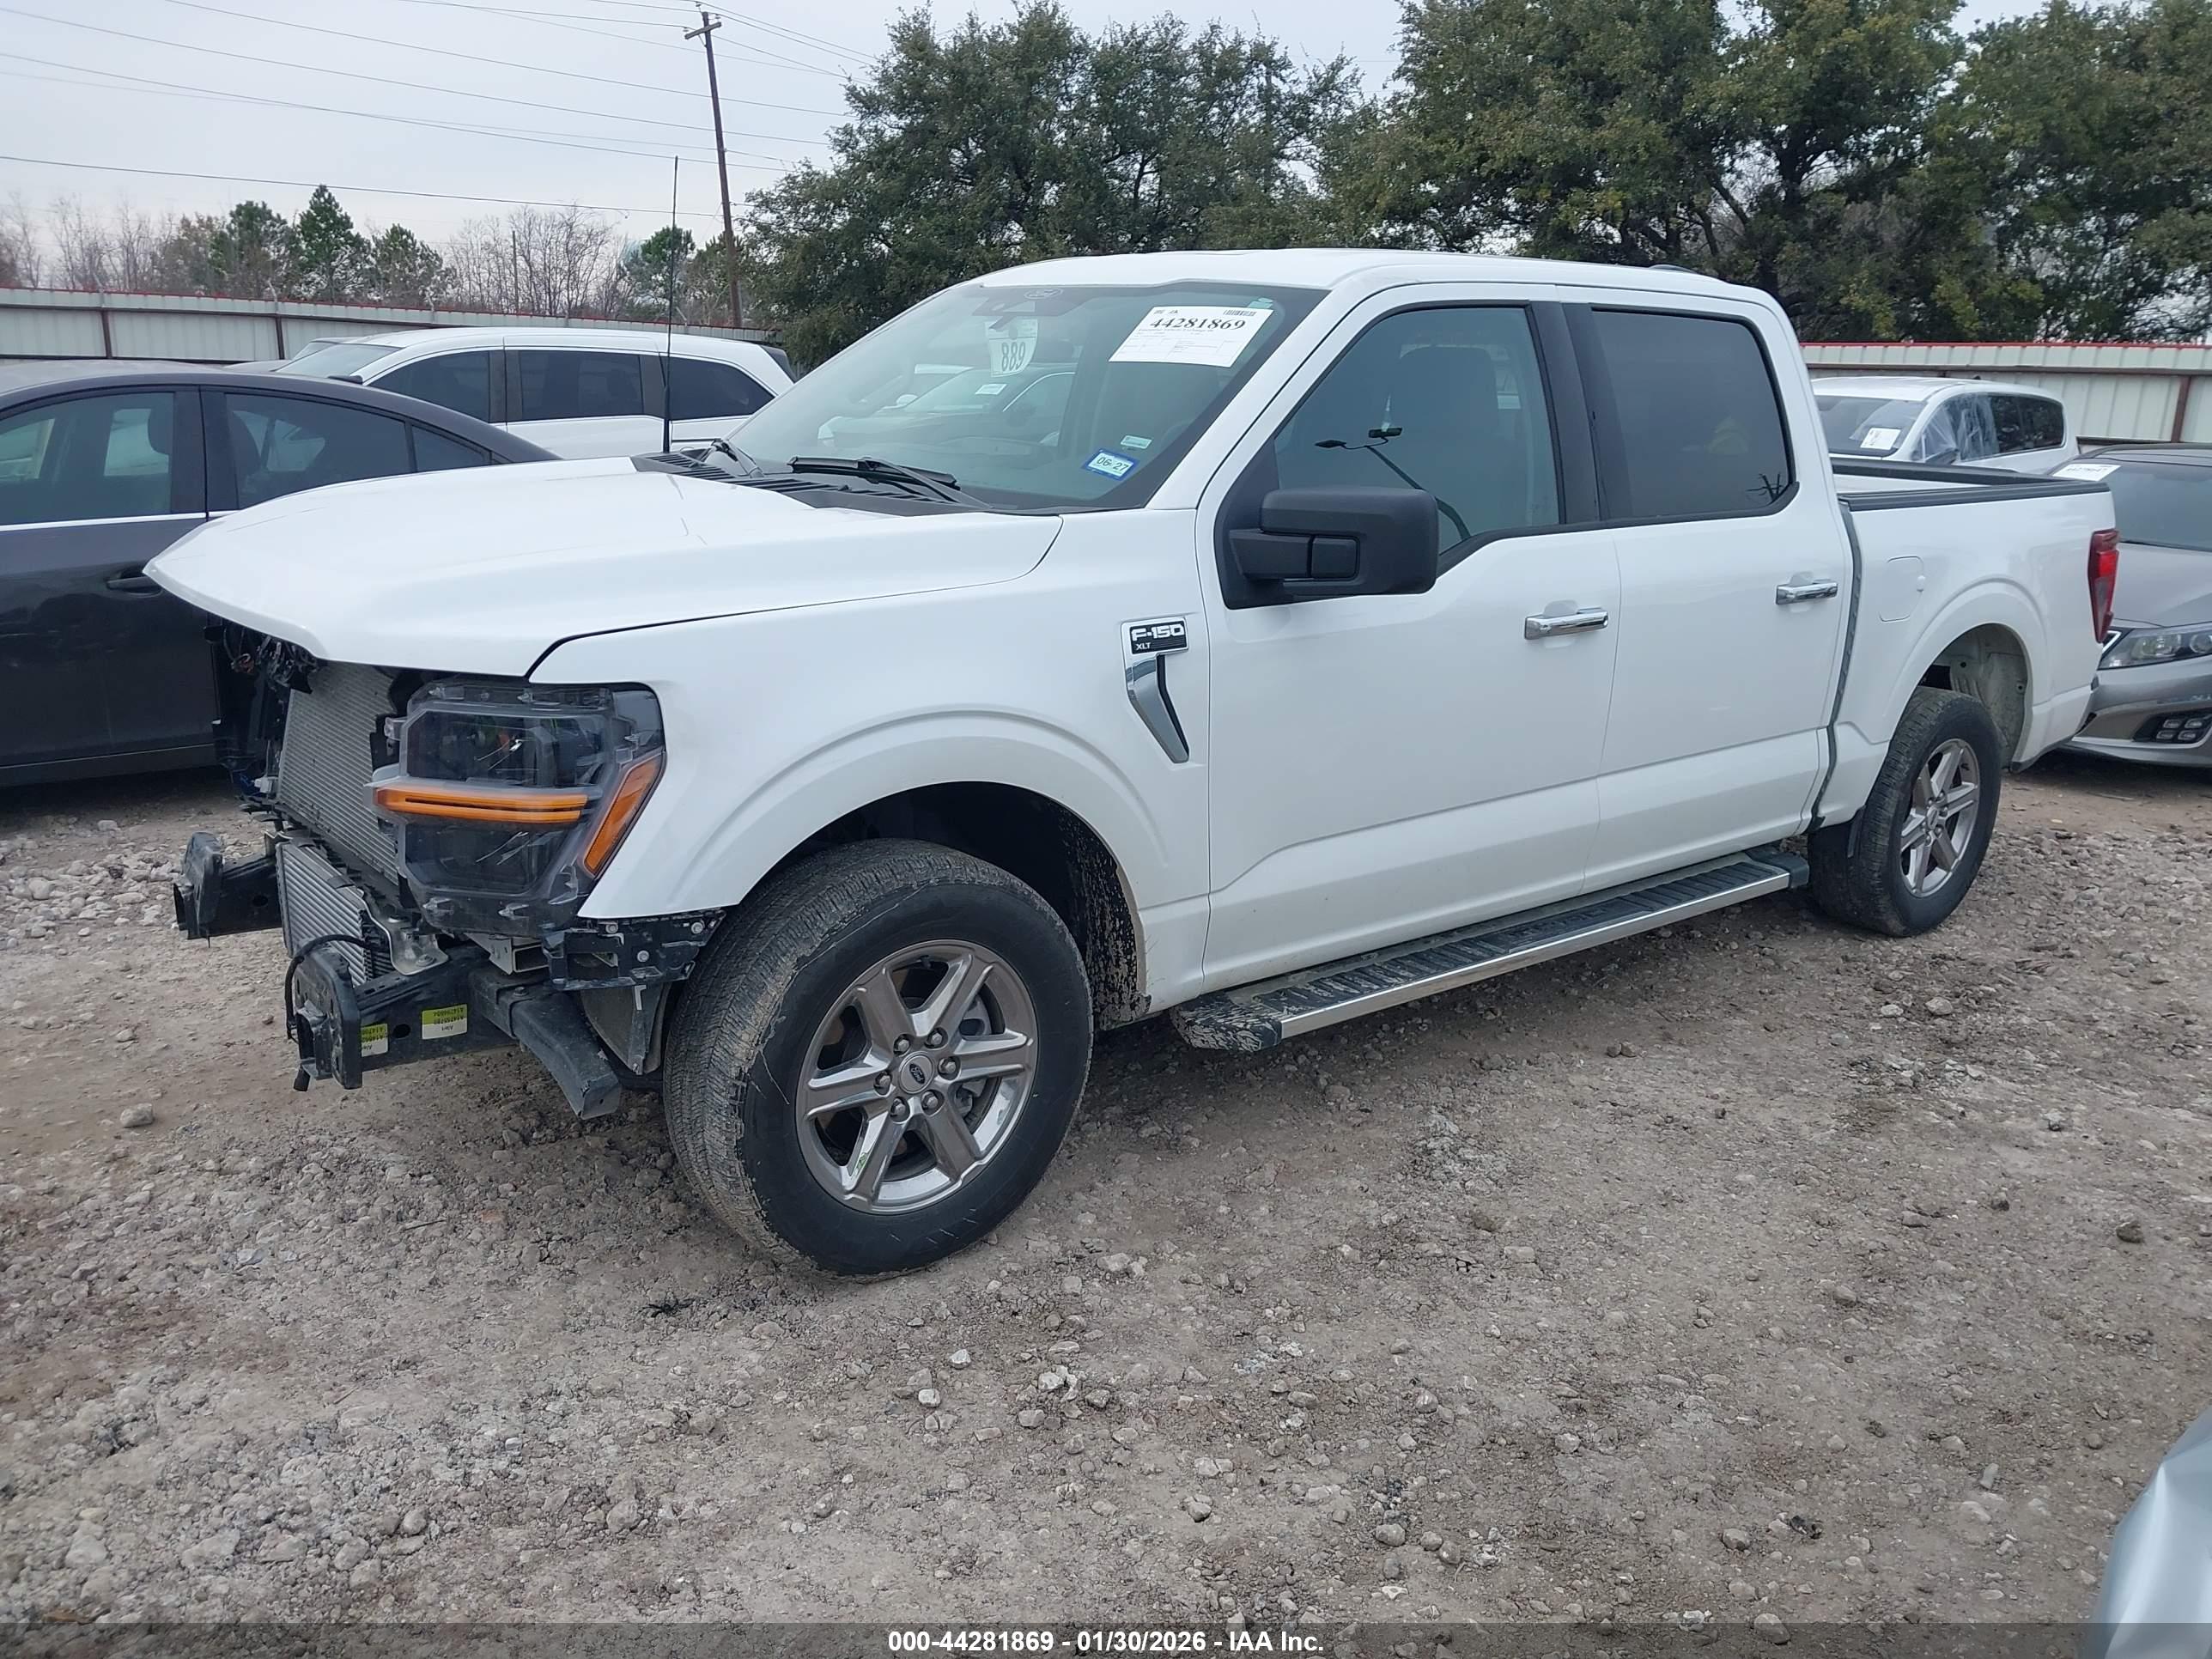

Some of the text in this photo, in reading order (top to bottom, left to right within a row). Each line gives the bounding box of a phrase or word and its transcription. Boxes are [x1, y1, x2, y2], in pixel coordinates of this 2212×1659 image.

[1150, 317, 1246, 331] 44281869
[1001, 342, 1025, 372] 889
[1131, 623, 1185, 641] F-150
[1135, 641, 1152, 651] XLT
